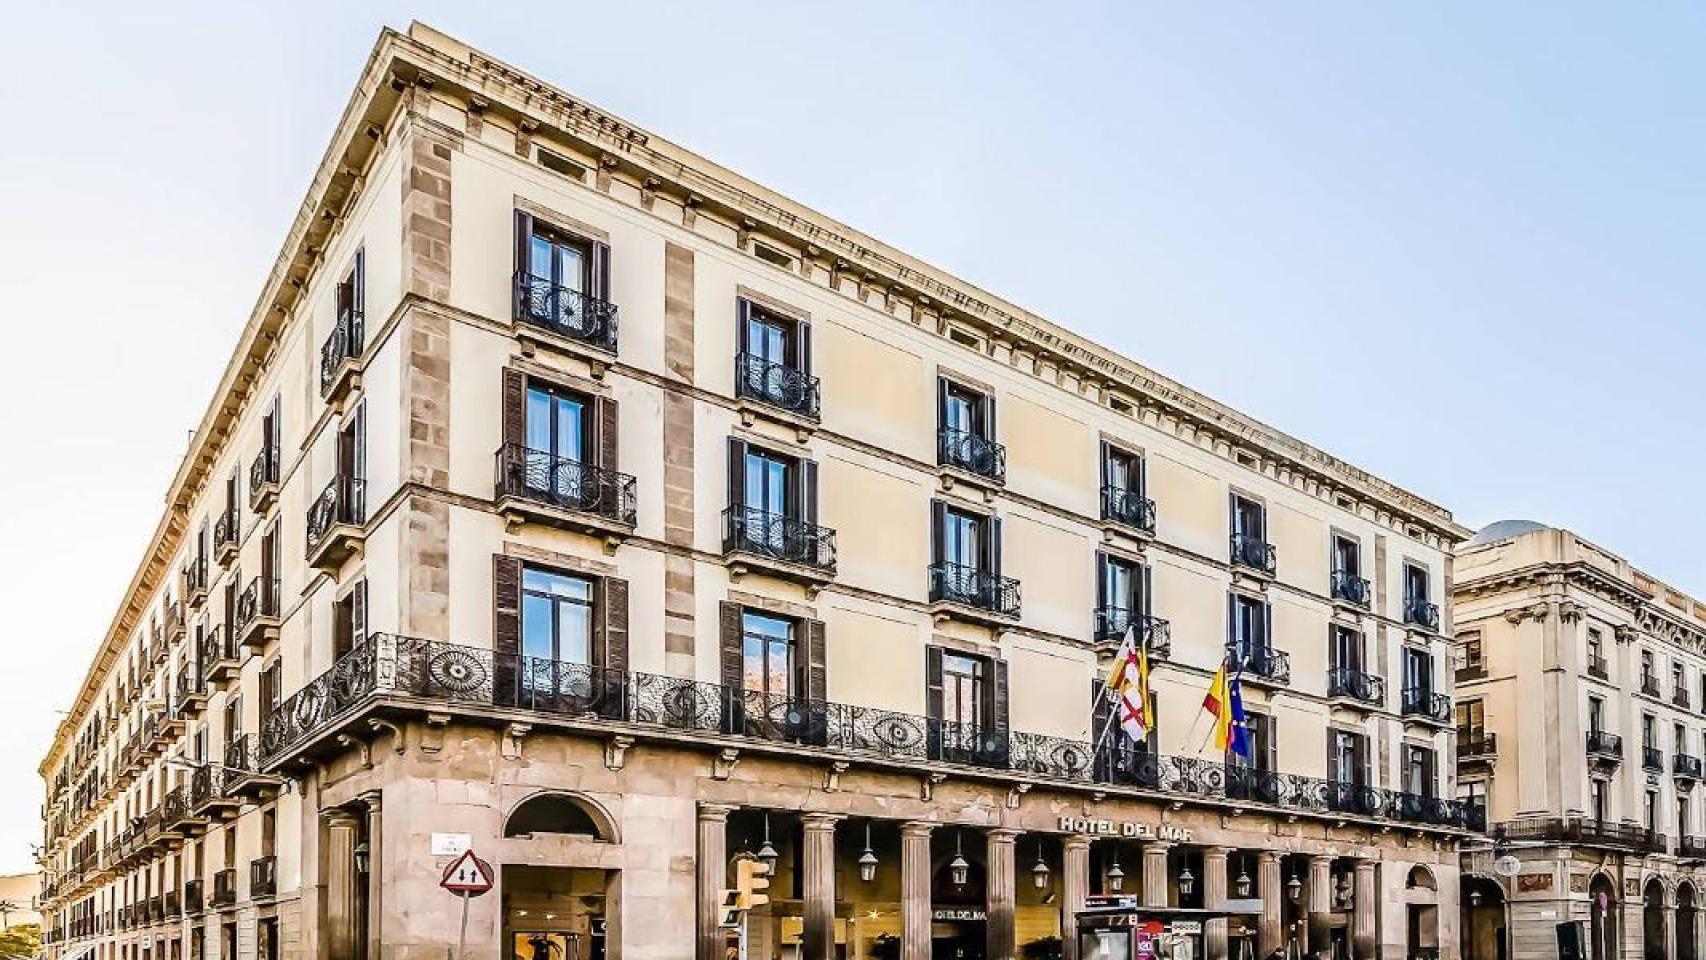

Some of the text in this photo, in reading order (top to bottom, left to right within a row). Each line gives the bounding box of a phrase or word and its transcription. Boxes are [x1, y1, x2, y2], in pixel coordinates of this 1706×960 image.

[1059, 816, 1194, 841] HOTEL DEL MAR
[973, 911, 988, 921] MA
